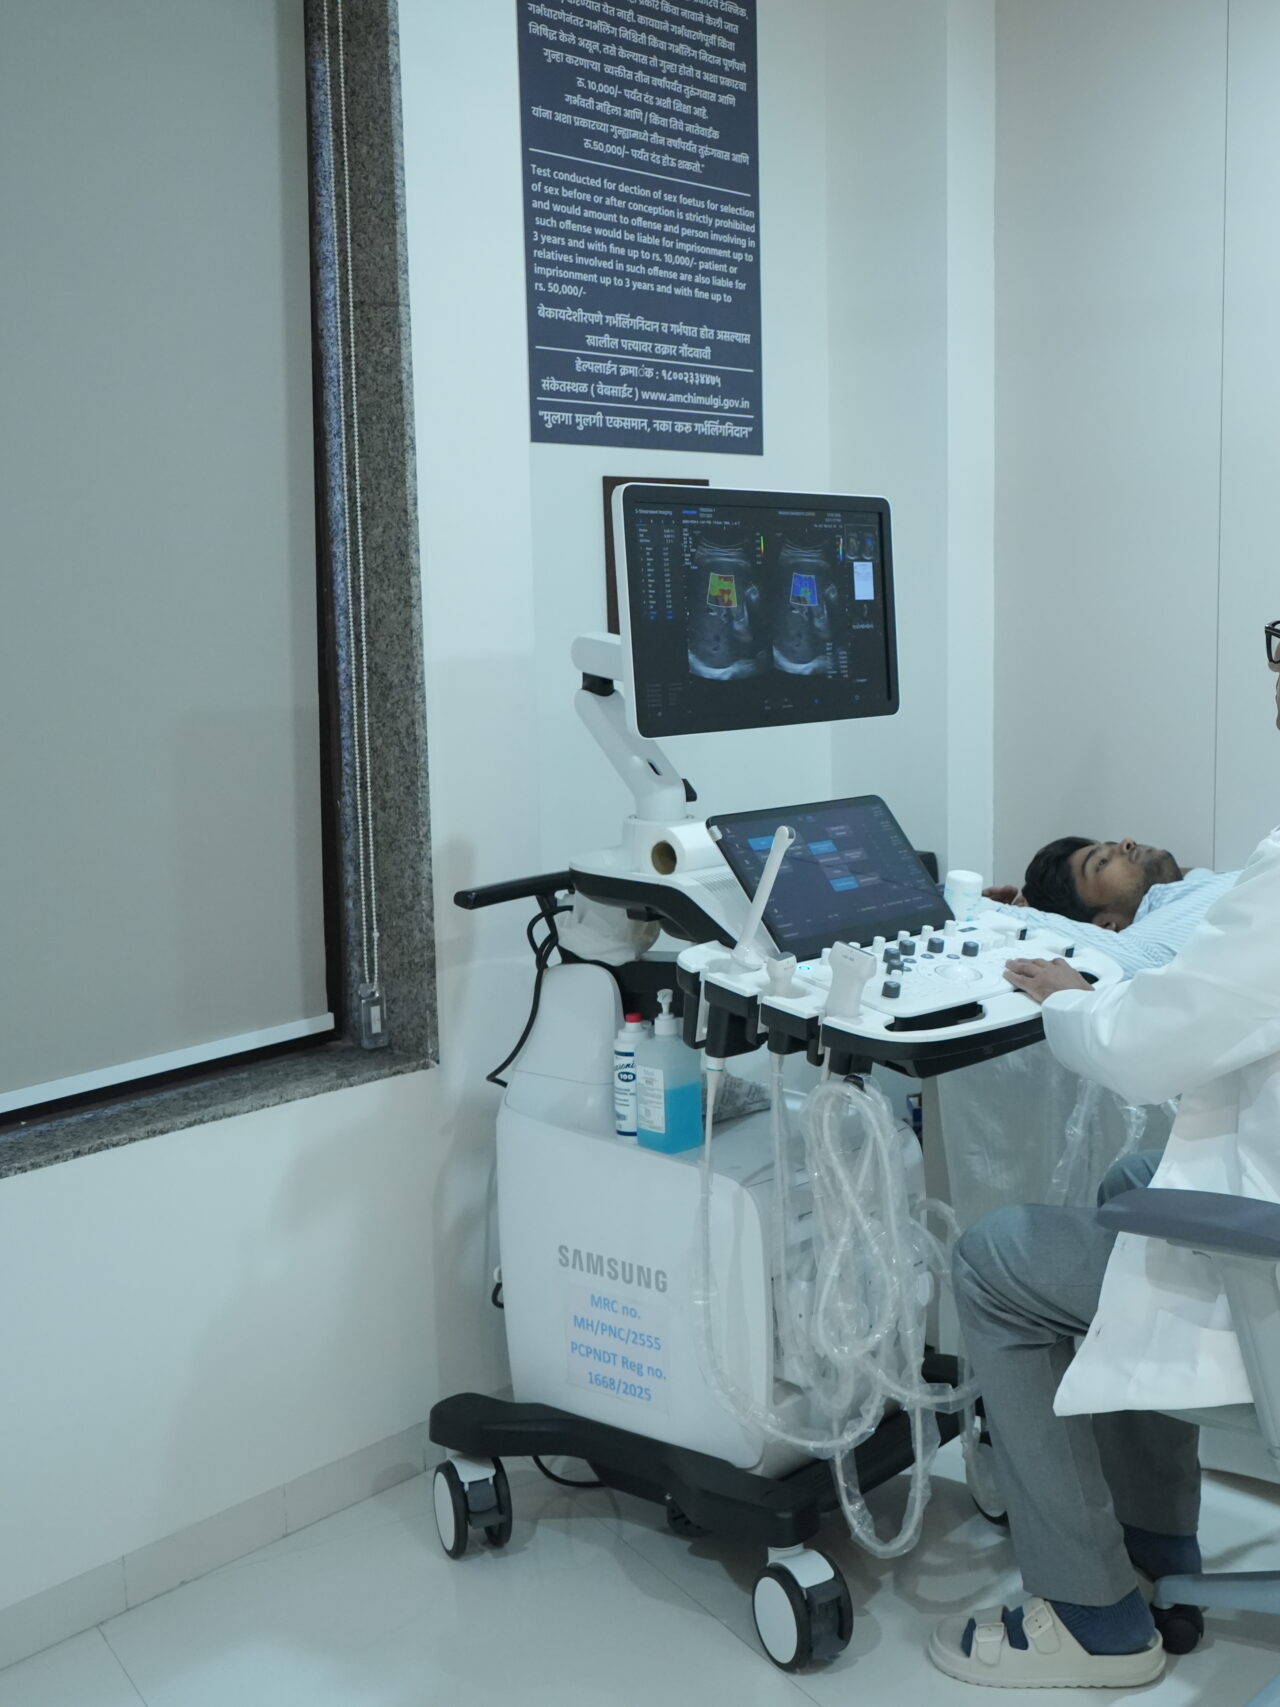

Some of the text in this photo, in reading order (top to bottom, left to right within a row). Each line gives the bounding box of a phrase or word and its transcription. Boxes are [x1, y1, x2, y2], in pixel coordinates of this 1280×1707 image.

[530, 163, 754, 217] Test conducted for dection of sex foetus for selection
[531, 181, 754, 232] of sex before or after conception is strictly prohibited
[531, 199, 754, 248] and would amount to offense and person involving in
[534, 216, 753, 262] such offense would be liable for imprisonment up to
[532, 230, 737, 273] 3 years and with fine up to rs. 10,000/- patient or
[533, 247, 746, 289] relatives involved in such offense are also liable for
[533, 262, 732, 303] imprisonment up to 3 years and with fine up to
[534, 282, 586, 297] rs. 50,000/-
[640, 390, 749, 409] www.amchimulgi.gov.in
[557, 1244, 669, 1293] SAMSUNG
[590, 1294, 641, 1319] MRC no.
[573, 1315, 662, 1351] MH/PNC/2555
[570, 1341, 667, 1380] PCPNDT Reg no.
[588, 1371, 652, 1401] 1668/2025
